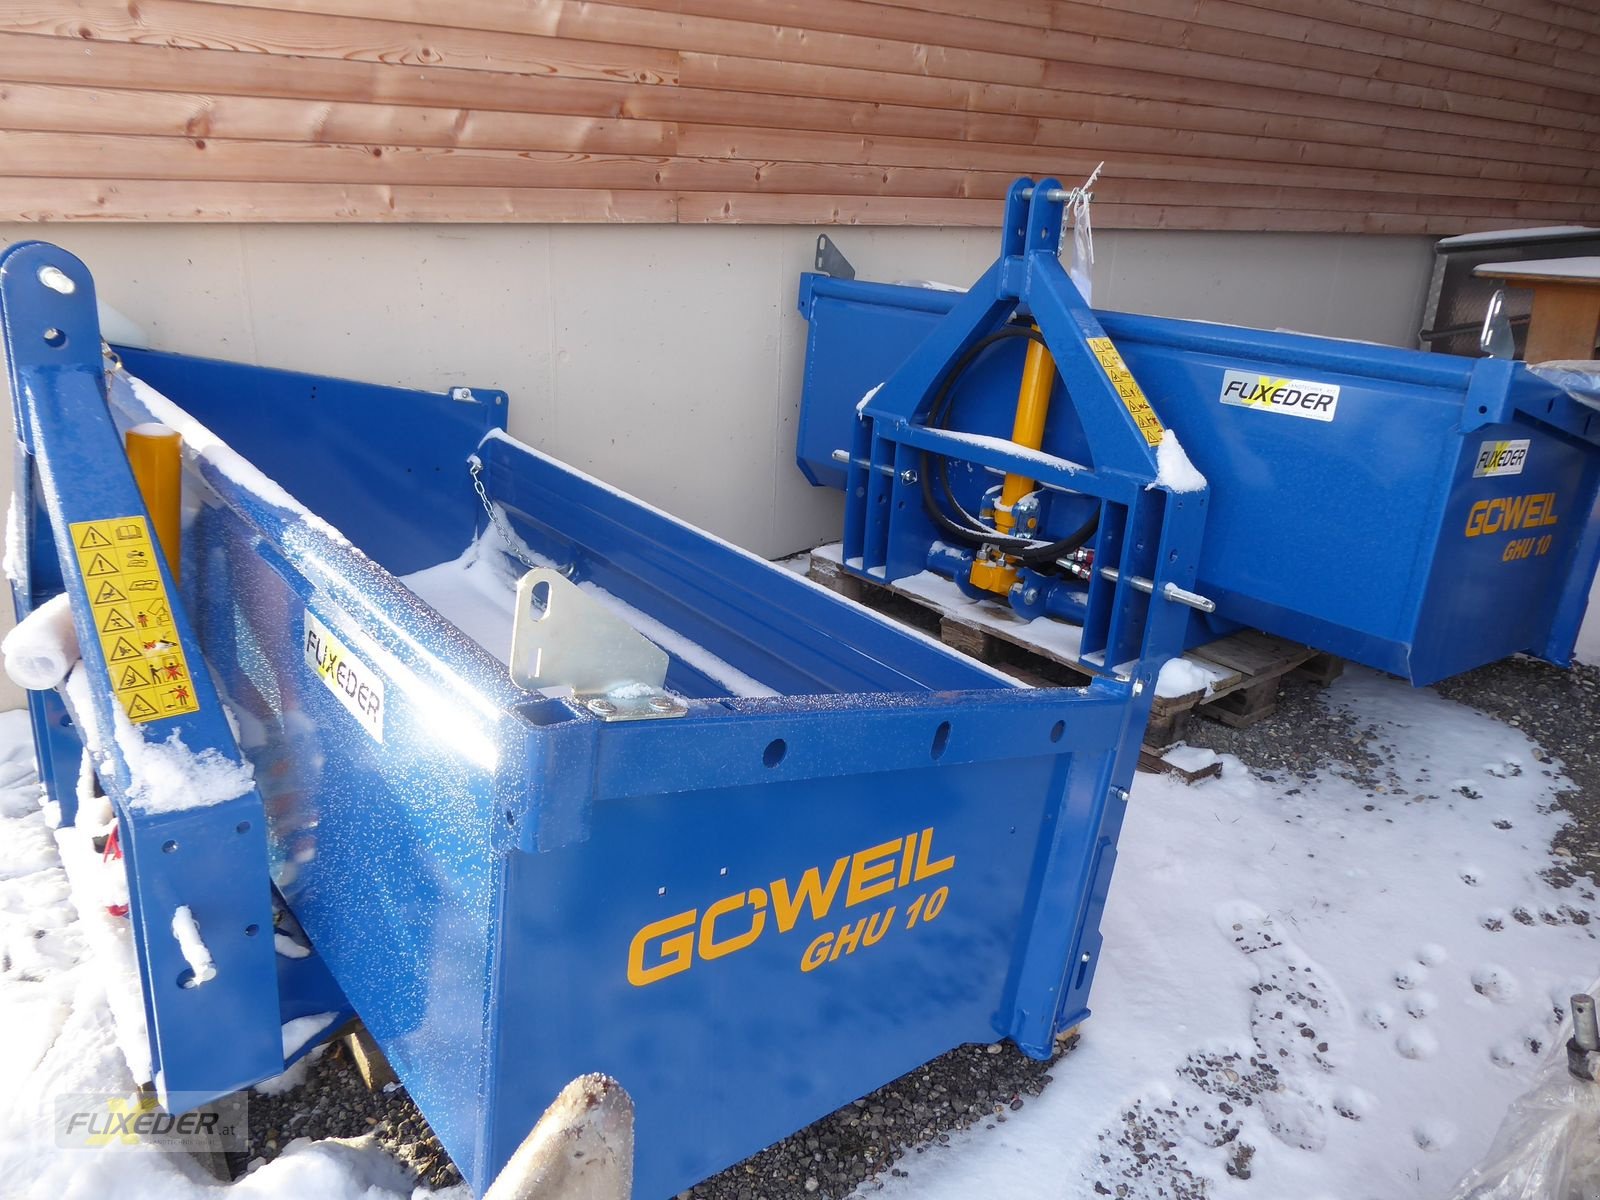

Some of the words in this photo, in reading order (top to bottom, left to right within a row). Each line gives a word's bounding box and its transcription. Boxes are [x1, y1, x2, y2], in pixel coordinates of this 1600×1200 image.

[1223, 380, 1335, 412] FLIXEDER
[1476, 448, 1527, 469] FLIXEDER
[1502, 537, 1536, 561] GHU
[1535, 534, 1553, 555] 10
[306, 629, 380, 723] FLIXEDER
[800, 905, 897, 973] GHU
[905, 886, 949, 930] 10
